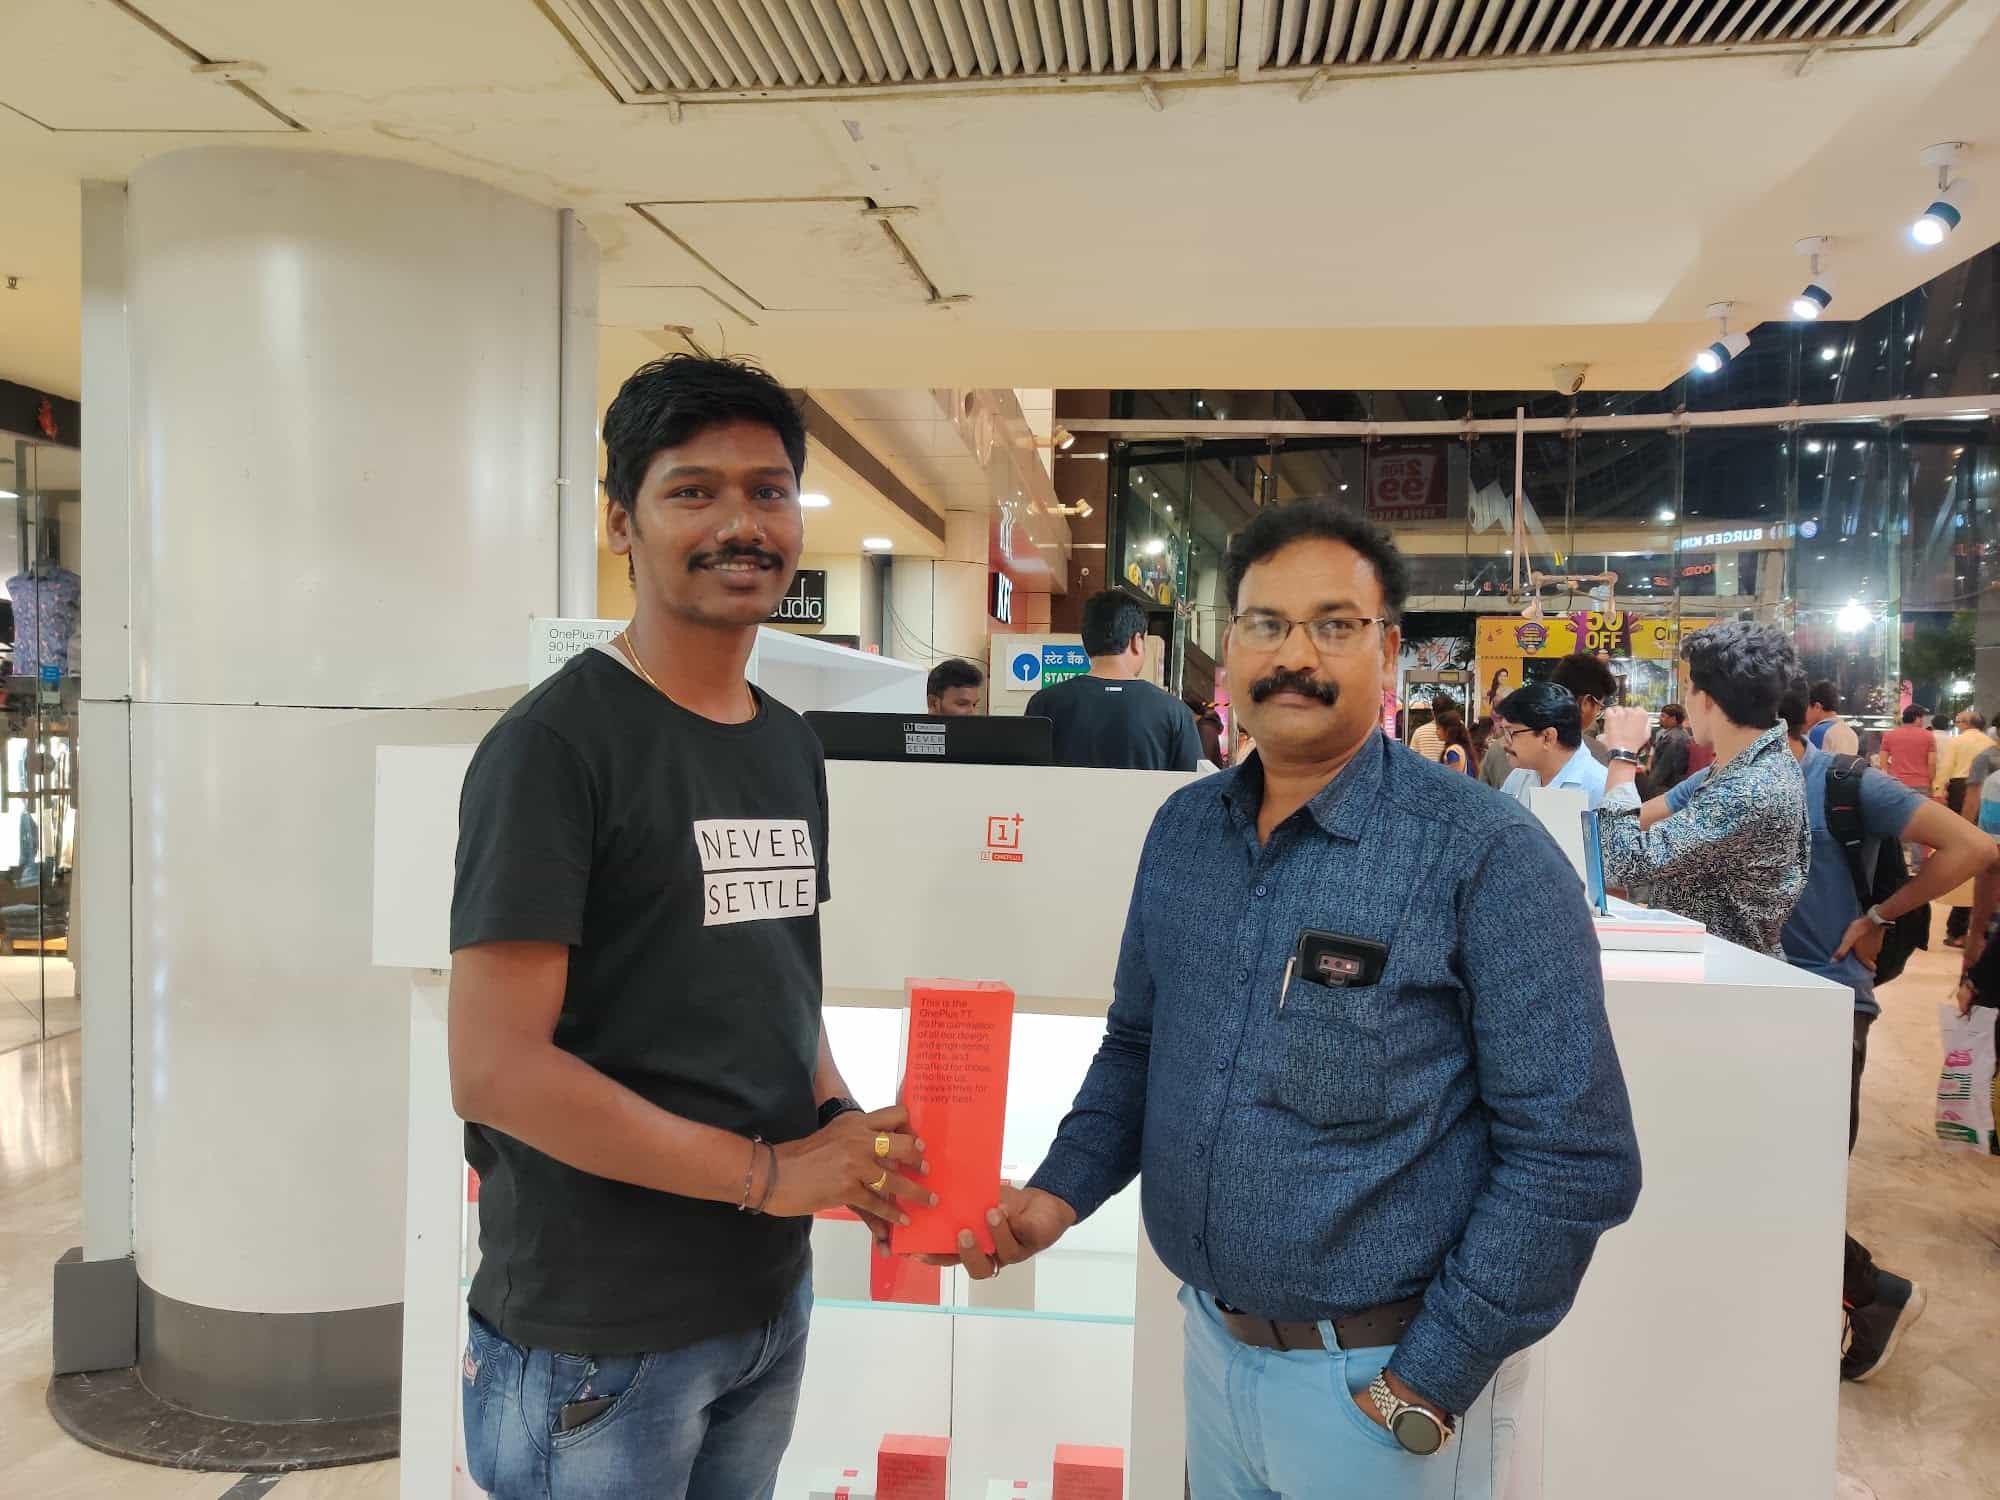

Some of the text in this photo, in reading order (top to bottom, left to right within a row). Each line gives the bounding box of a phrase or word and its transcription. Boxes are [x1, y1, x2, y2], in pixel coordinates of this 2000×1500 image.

[549, 628, 594, 640] OnePlus
[596, 629, 609, 640] 7T
[1585, 632, 1623, 649] OFF
[548, 641, 563, 652] 90
[566, 642, 581, 652] Hz
[701, 829, 809, 860] NEVER
[709, 880, 809, 915] SETTLE
